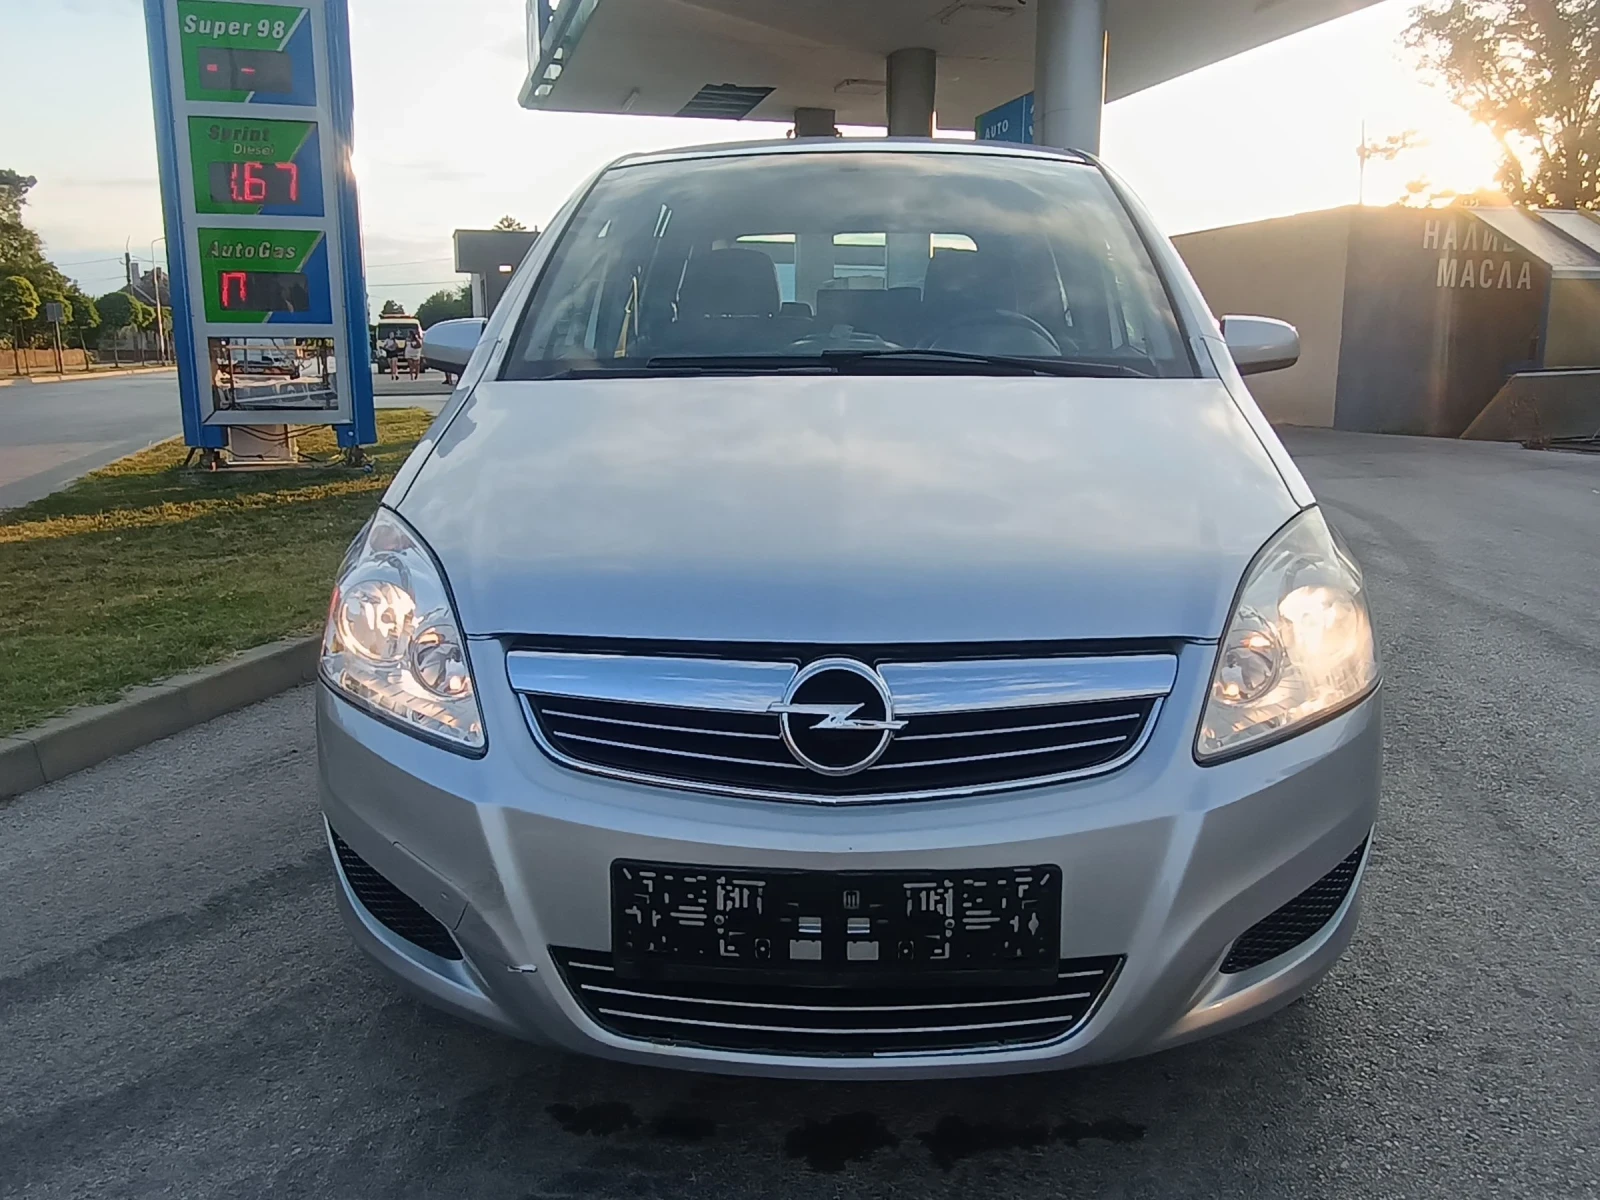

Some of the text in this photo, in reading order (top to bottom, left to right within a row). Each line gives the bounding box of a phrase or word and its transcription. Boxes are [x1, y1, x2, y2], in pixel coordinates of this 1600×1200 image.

[184, 14, 285, 39] Super 98
[208, 124, 272, 143] Sprint
[985, 119, 1009, 140] AUTO
[233, 143, 275, 155] Diesel
[1423, 219, 1516, 253] НАЛИ
[207, 239, 297, 260] AutoGas
[1436, 257, 1532, 290] МАСЛА
